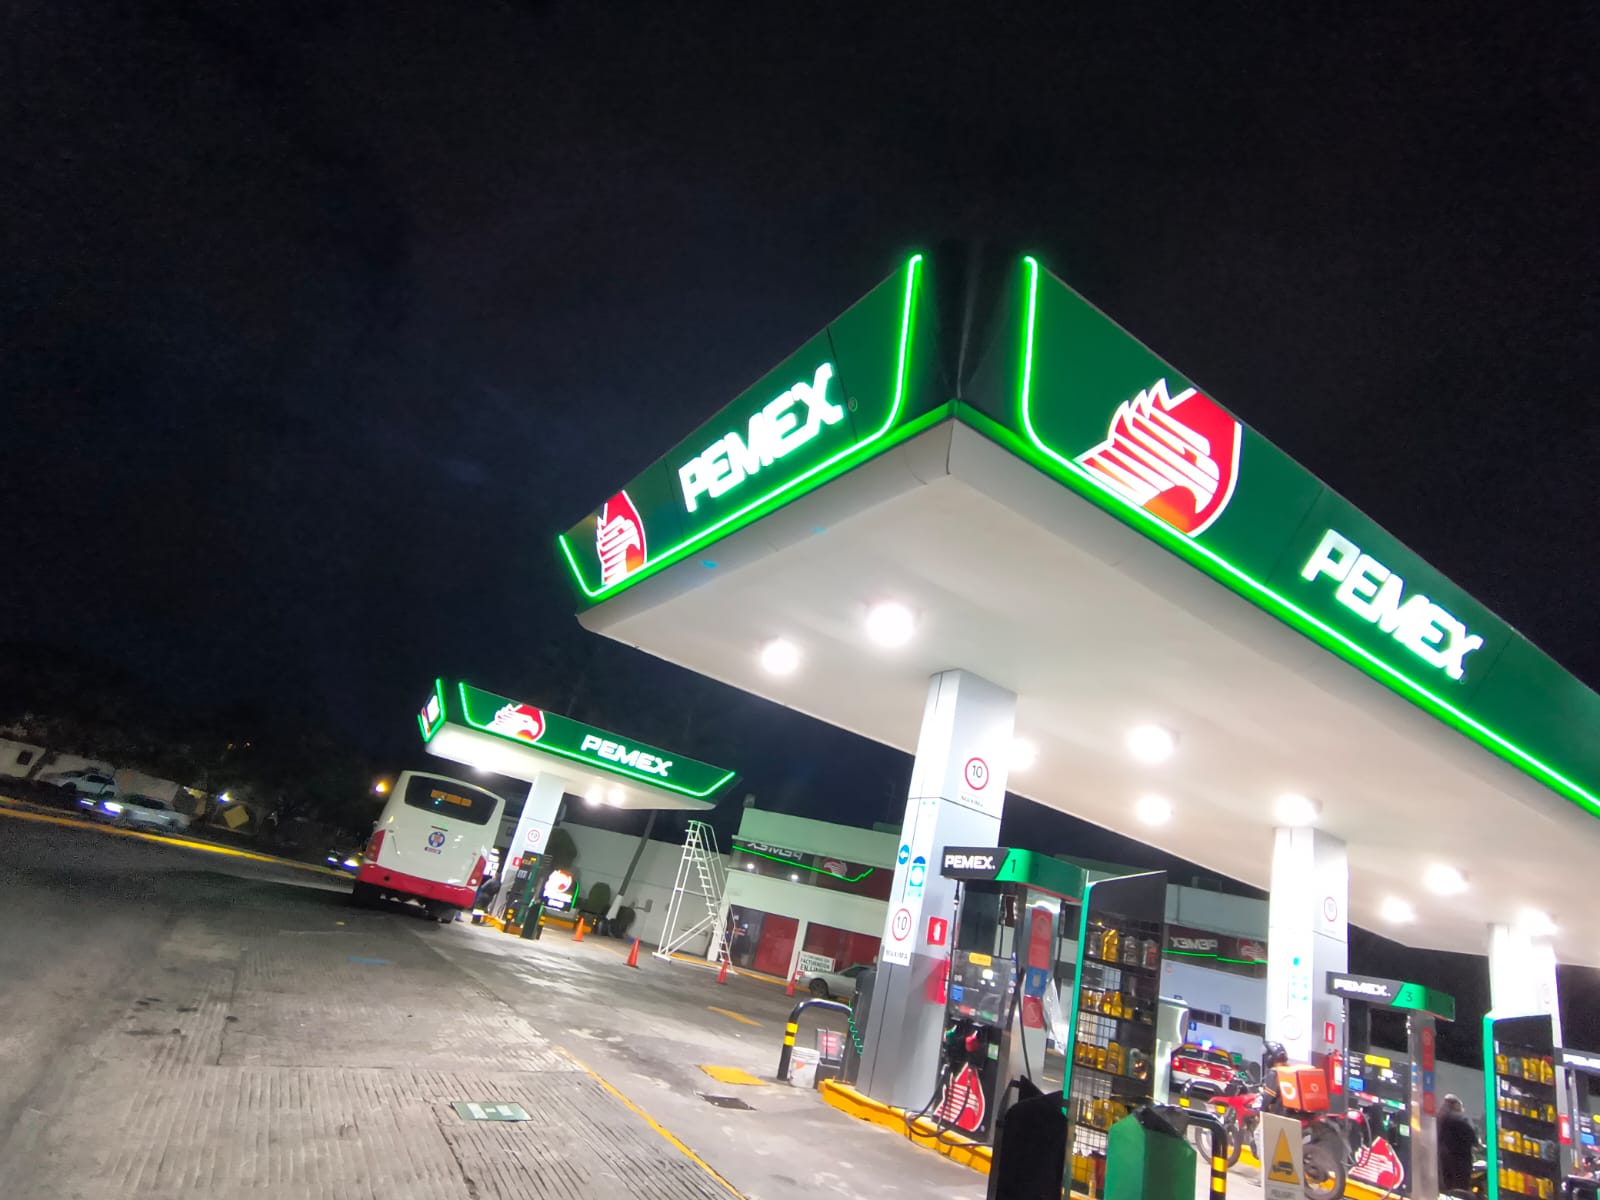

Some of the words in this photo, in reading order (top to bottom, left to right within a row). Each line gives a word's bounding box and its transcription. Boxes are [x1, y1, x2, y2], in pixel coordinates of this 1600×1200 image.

[678, 362, 844, 513] PEMEX
[1301, 528, 1485, 681] PEMEX
[580, 734, 673, 777] PEMEX
[972, 765, 983, 778] 10
[1011, 858, 1016, 873] 1
[896, 915, 908, 931] 10
[1405, 991, 1414, 1002] 3
